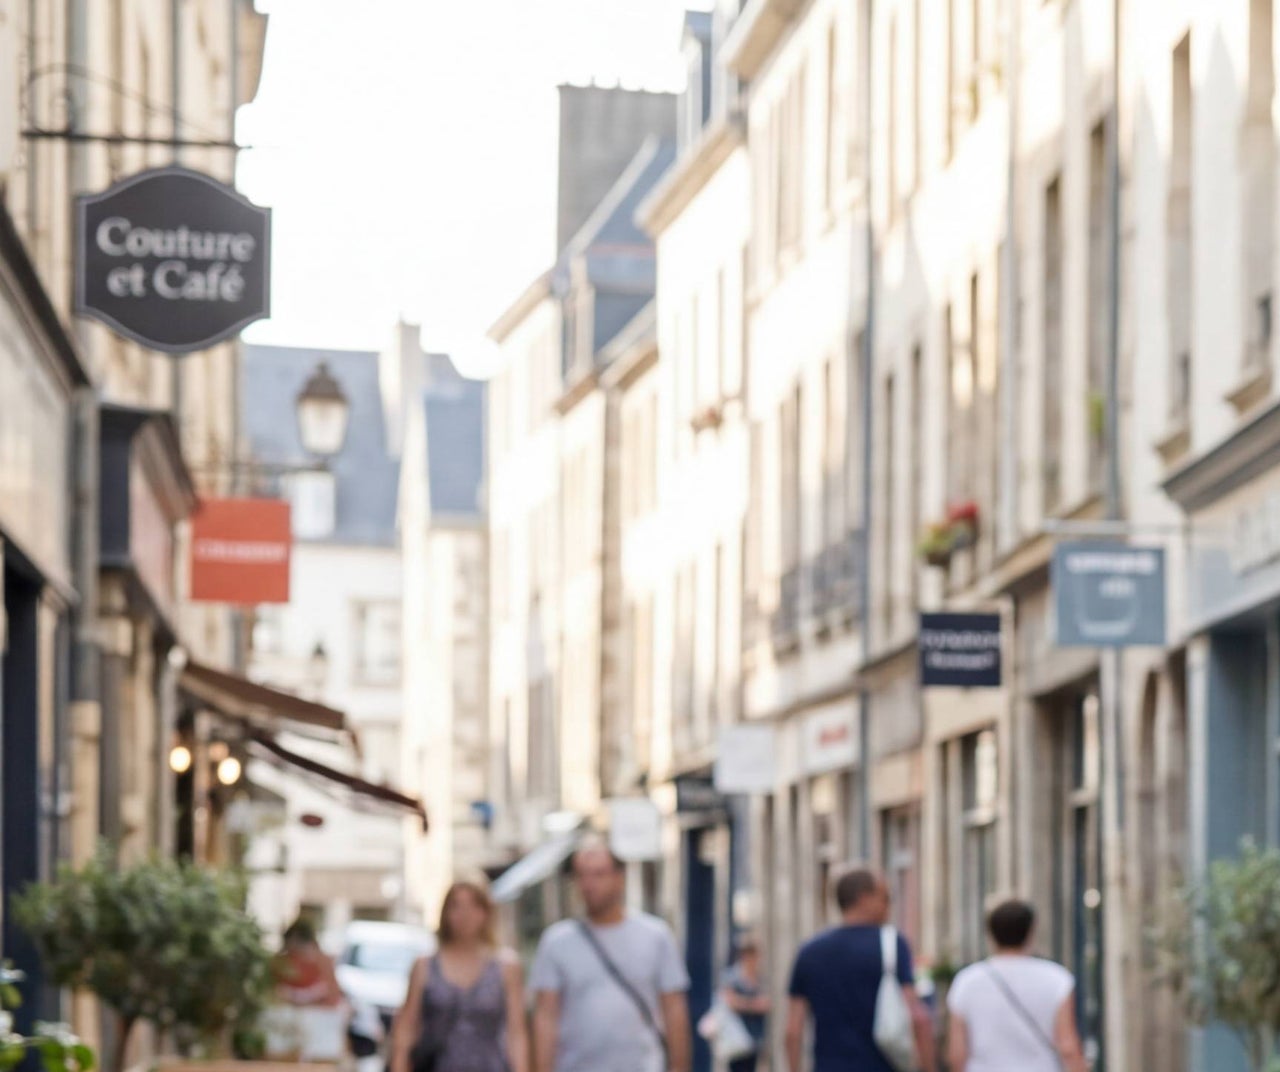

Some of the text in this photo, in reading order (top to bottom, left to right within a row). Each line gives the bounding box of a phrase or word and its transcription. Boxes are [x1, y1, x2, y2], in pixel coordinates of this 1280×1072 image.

[96, 216, 255, 262] Couture
[106, 259, 246, 302] et Café
